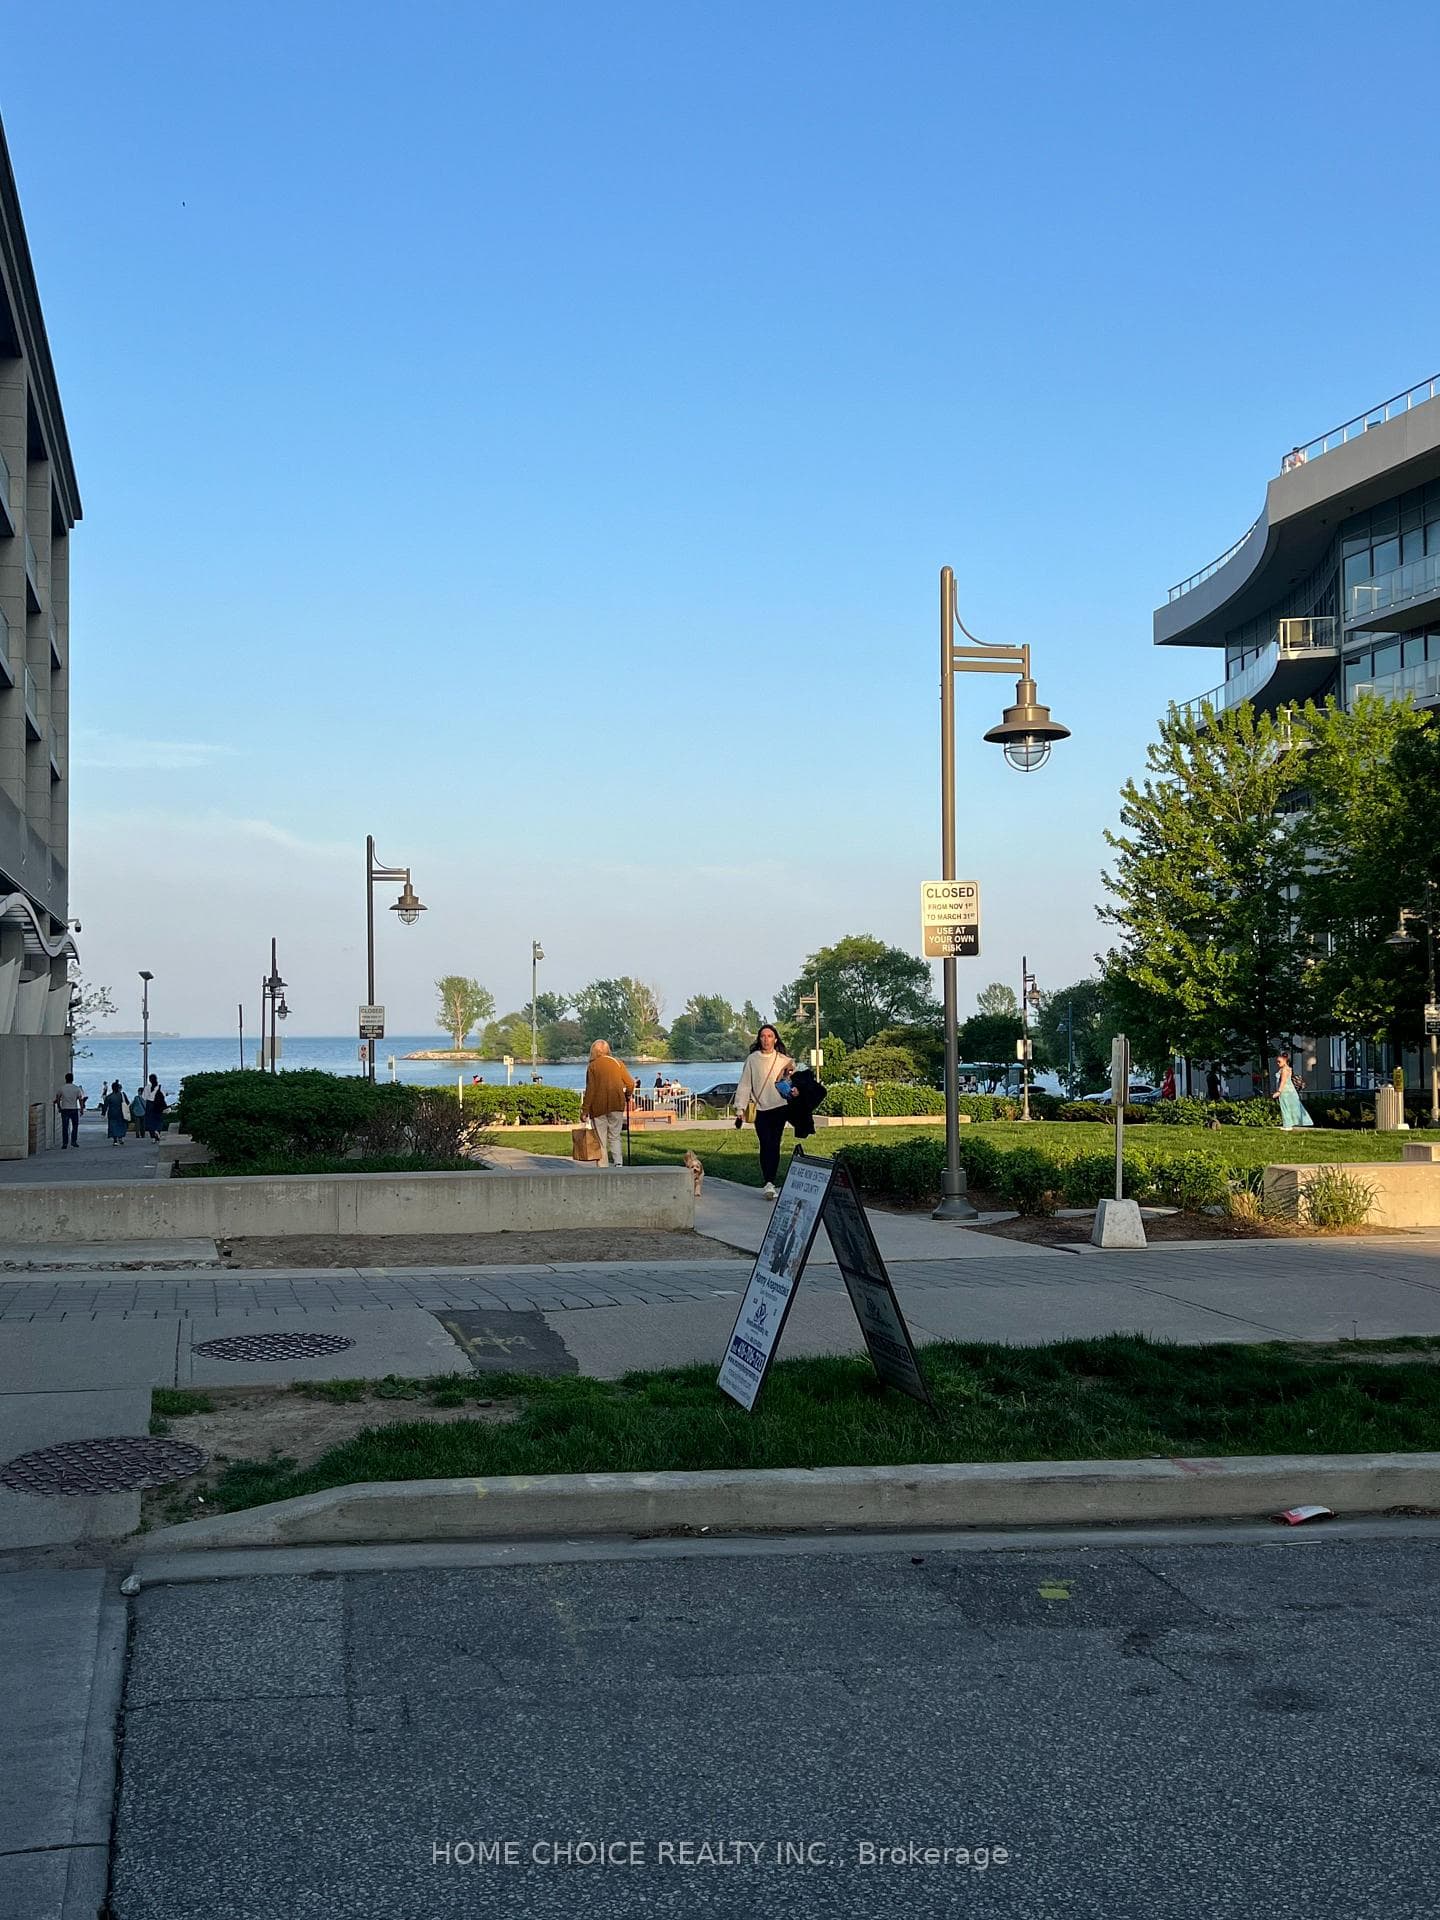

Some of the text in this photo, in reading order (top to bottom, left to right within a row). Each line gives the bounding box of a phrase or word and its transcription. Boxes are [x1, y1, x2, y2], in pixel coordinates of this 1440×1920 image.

[926, 887, 975, 898] CLOSED
[936, 926, 967, 935] USE AT
[928, 935, 975, 944] YOUR OWN
[942, 944, 962, 952] RISK
